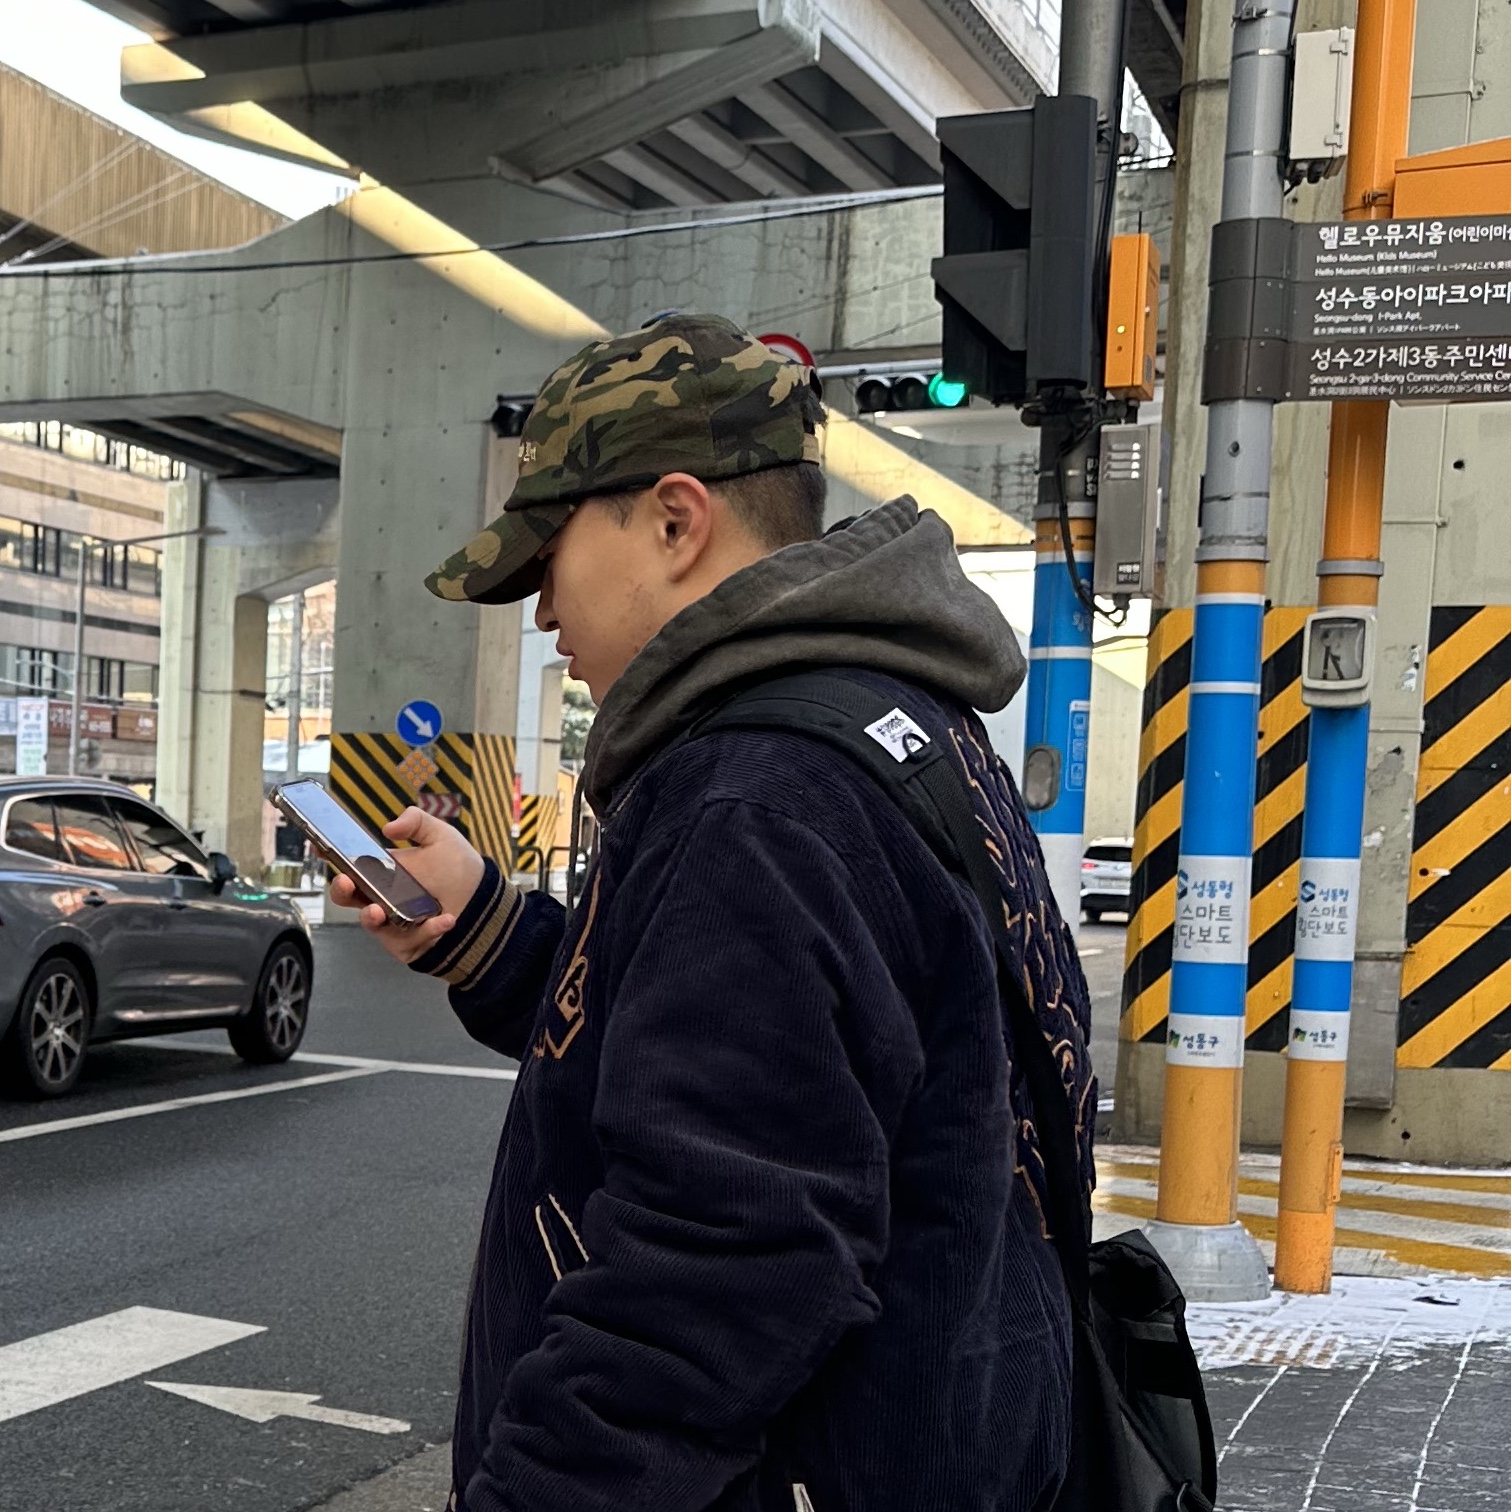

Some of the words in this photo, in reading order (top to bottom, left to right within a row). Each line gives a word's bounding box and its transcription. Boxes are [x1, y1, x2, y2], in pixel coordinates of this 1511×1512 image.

[1319, 221, 1447, 250] 헬로우뮤지움
[1448, 223, 1511, 243] (어린이미
[1311, 343, 1511, 371] 성수2가제3동주민센
[1406, 371, 1460, 384] Community
[1460, 370, 1494, 383] Service
[1191, 880, 1233, 900] 성동형
[1318, 888, 1349, 903] 성동형
[1180, 903, 1233, 922] 스마트
[1309, 904, 1348, 919] 스마트
[1182, 1033, 1220, 1050] 성동구
[1308, 1029, 1338, 1043] 성동구
